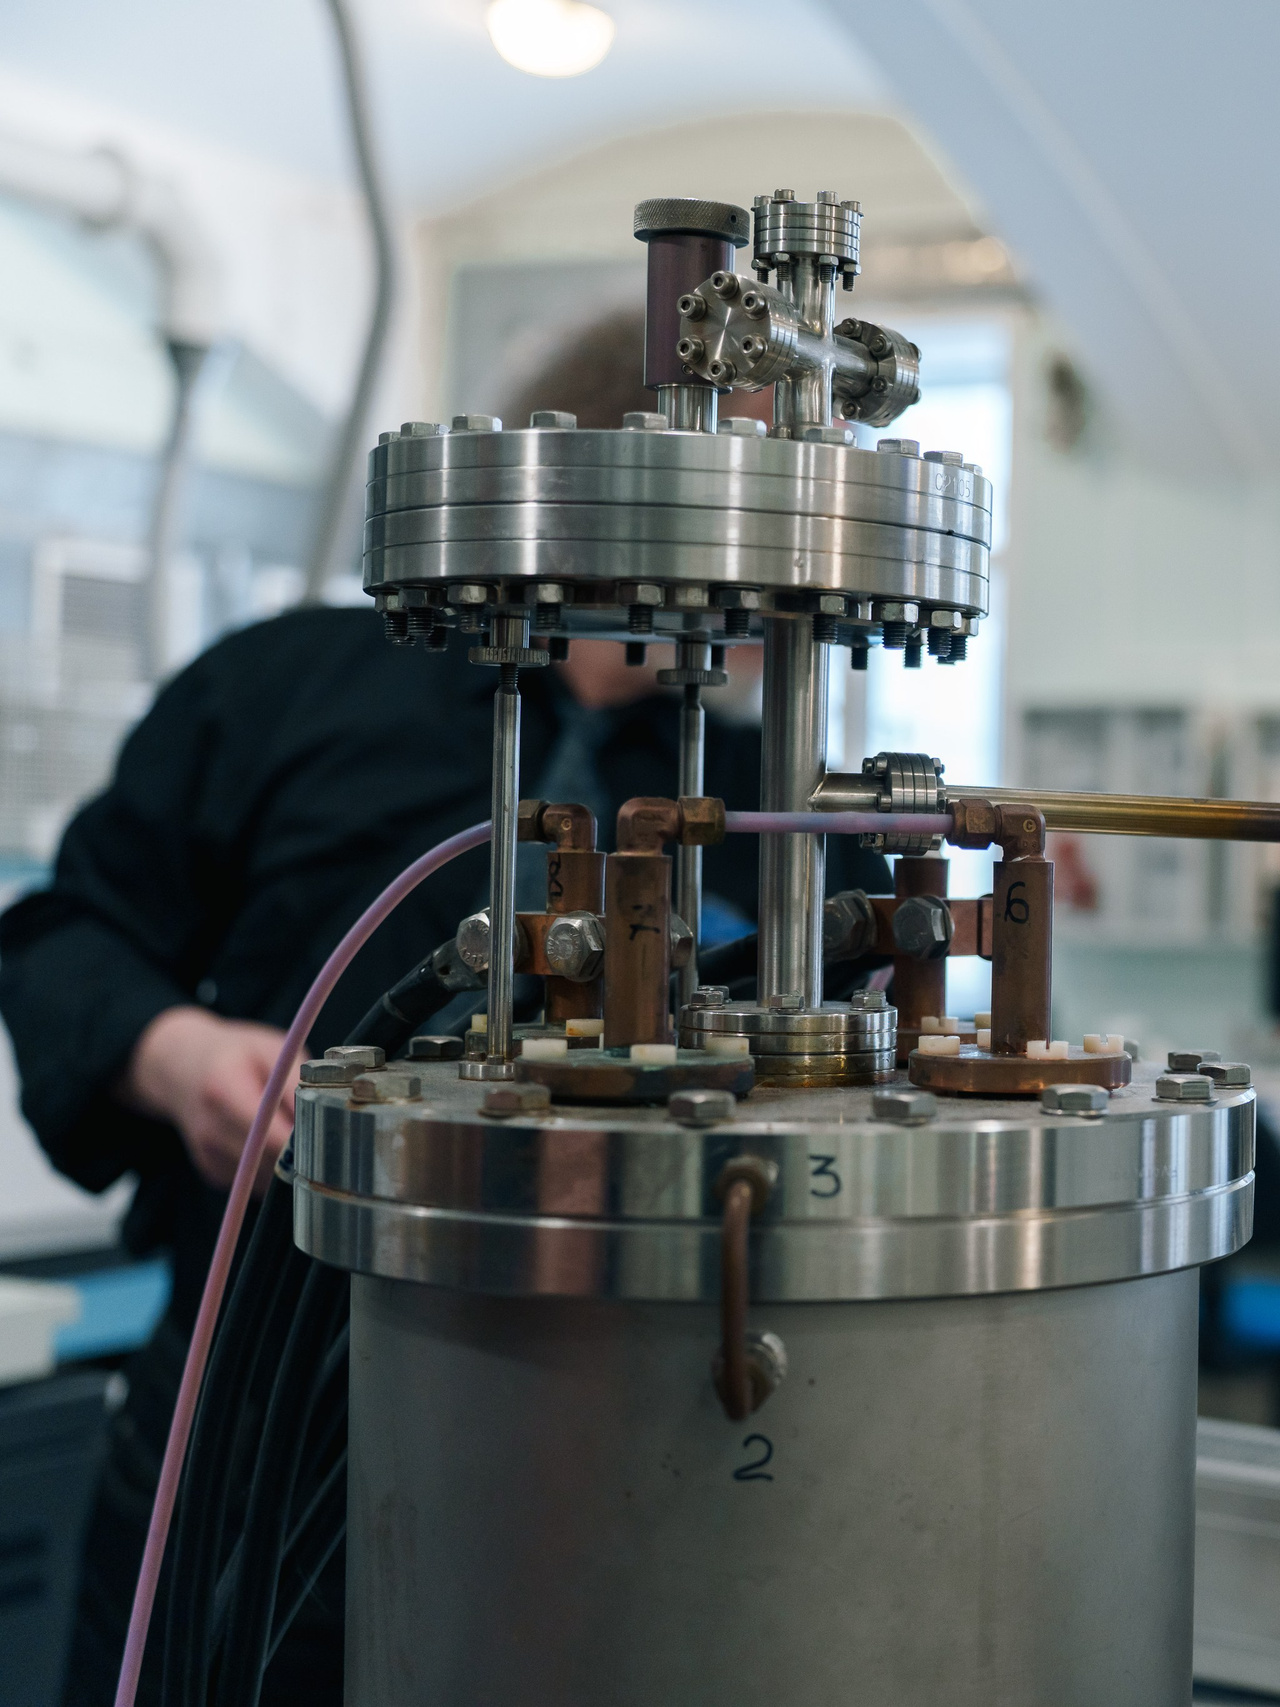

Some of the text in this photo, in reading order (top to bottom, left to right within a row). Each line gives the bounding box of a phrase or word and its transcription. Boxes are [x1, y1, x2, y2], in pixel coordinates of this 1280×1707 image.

[1004, 880, 1030, 925] 6
[809, 1155, 843, 1198] 3
[733, 1433, 775, 1482] 2
